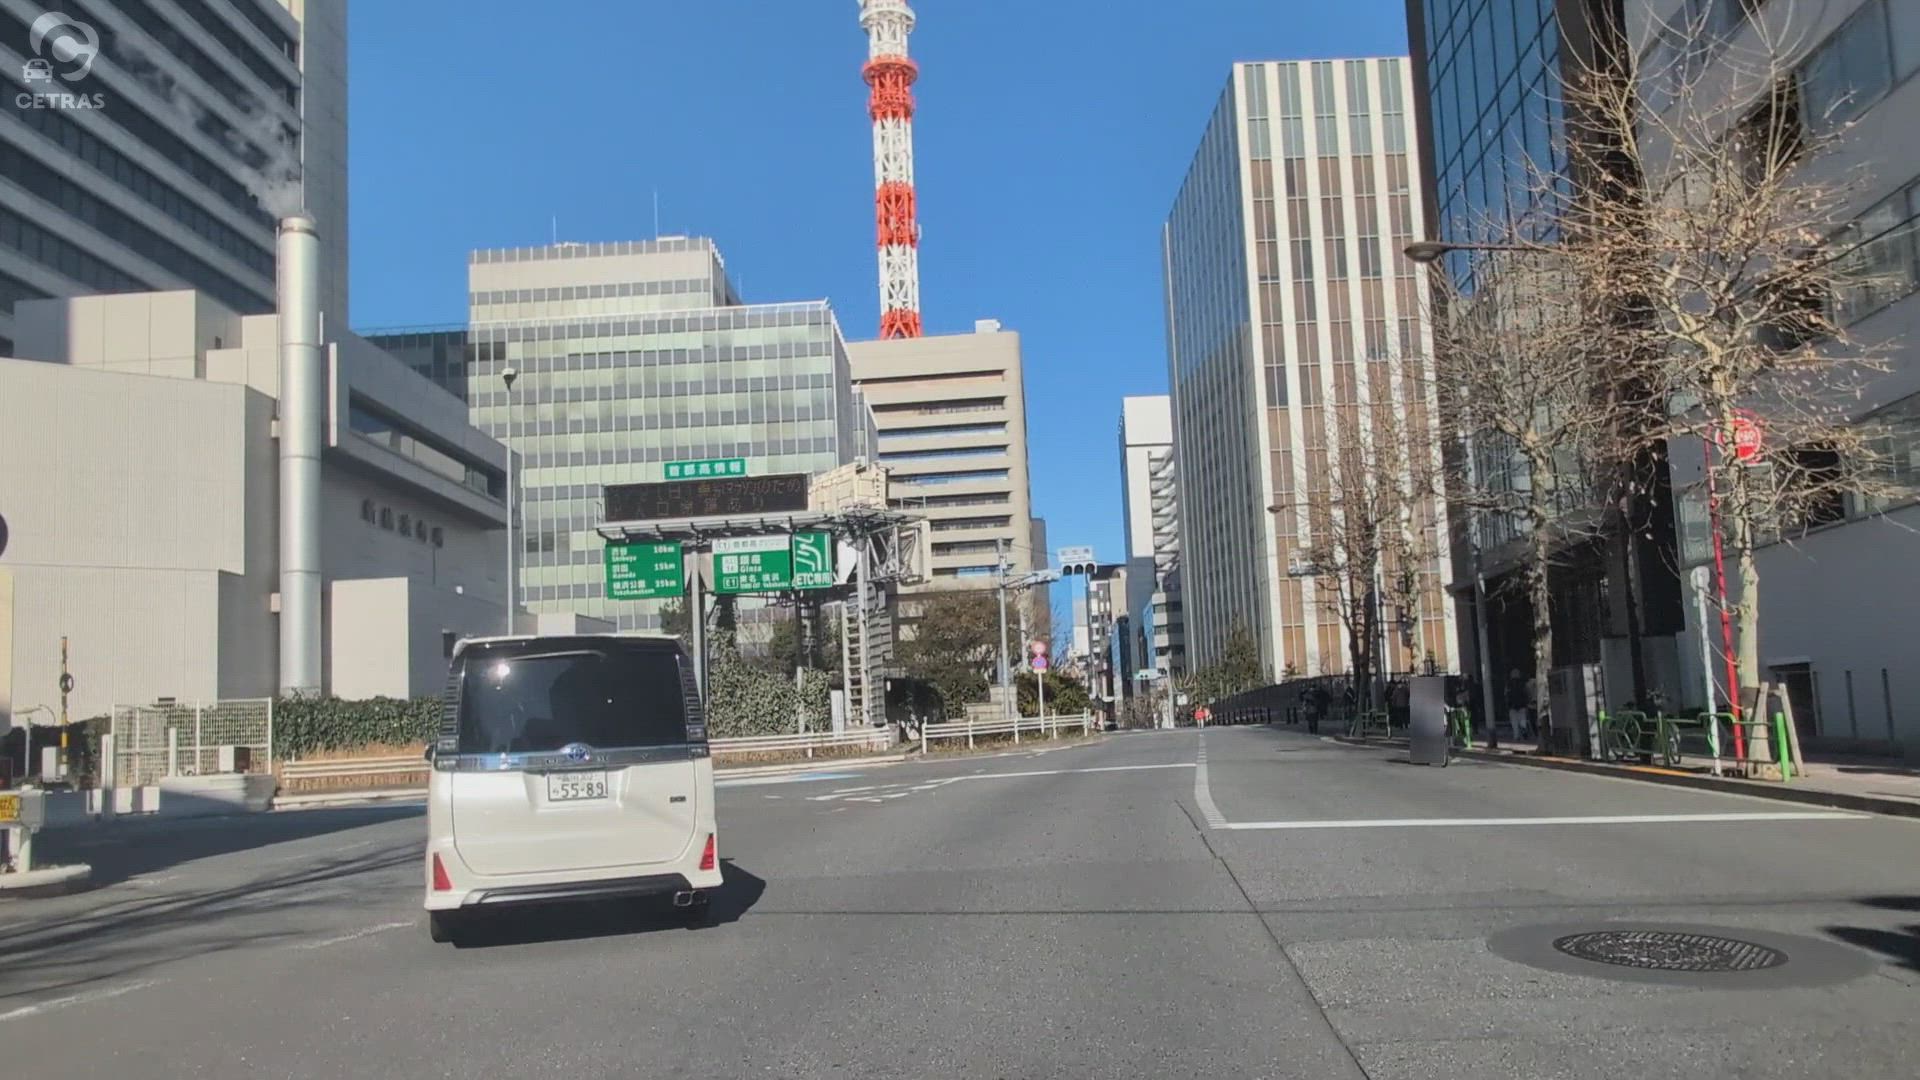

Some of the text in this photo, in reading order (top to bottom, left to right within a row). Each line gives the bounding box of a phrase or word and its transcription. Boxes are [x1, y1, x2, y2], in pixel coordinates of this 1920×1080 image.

[668, 462, 742, 477] 首都高情報
[739, 565, 762, 573] Ginza
[797, 571, 831, 586] ETC専用
[560, 782, 604, 799] 55-89
